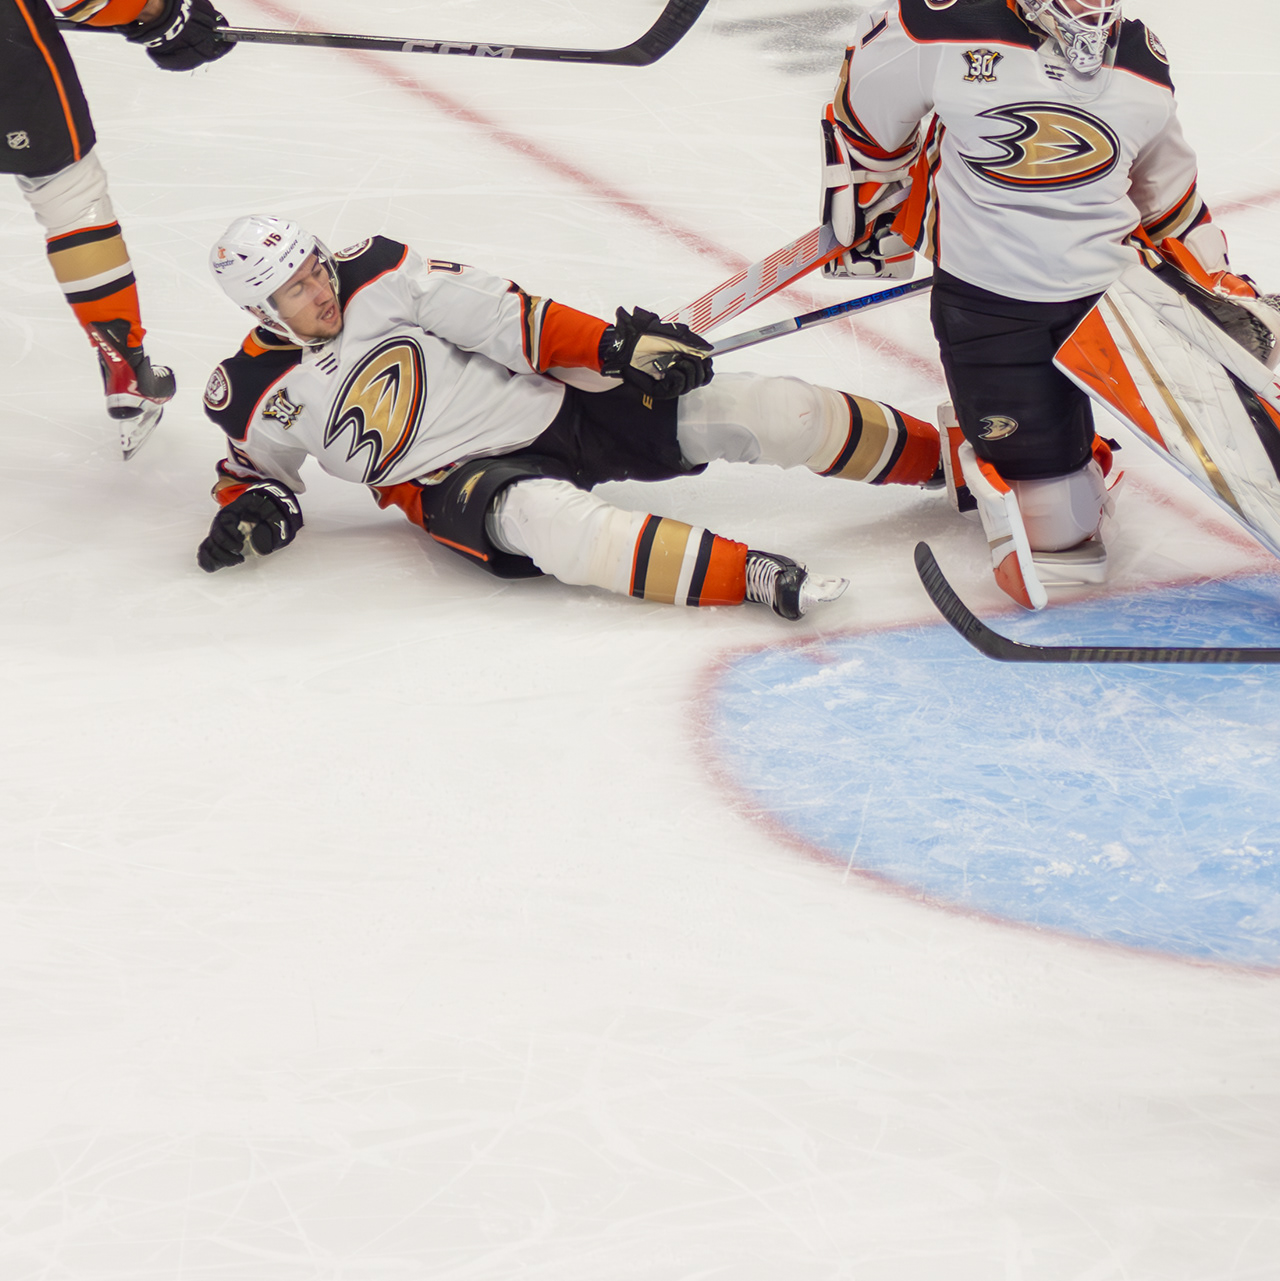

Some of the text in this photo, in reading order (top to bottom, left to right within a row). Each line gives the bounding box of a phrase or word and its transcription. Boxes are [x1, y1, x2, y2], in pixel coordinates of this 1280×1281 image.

[401, 39, 515, 60] CCM
[970, 54, 995, 77] 30
[262, 232, 283, 248] 46
[822, 286, 905, 319] JETSPEED
[270, 396, 297, 424] 30
